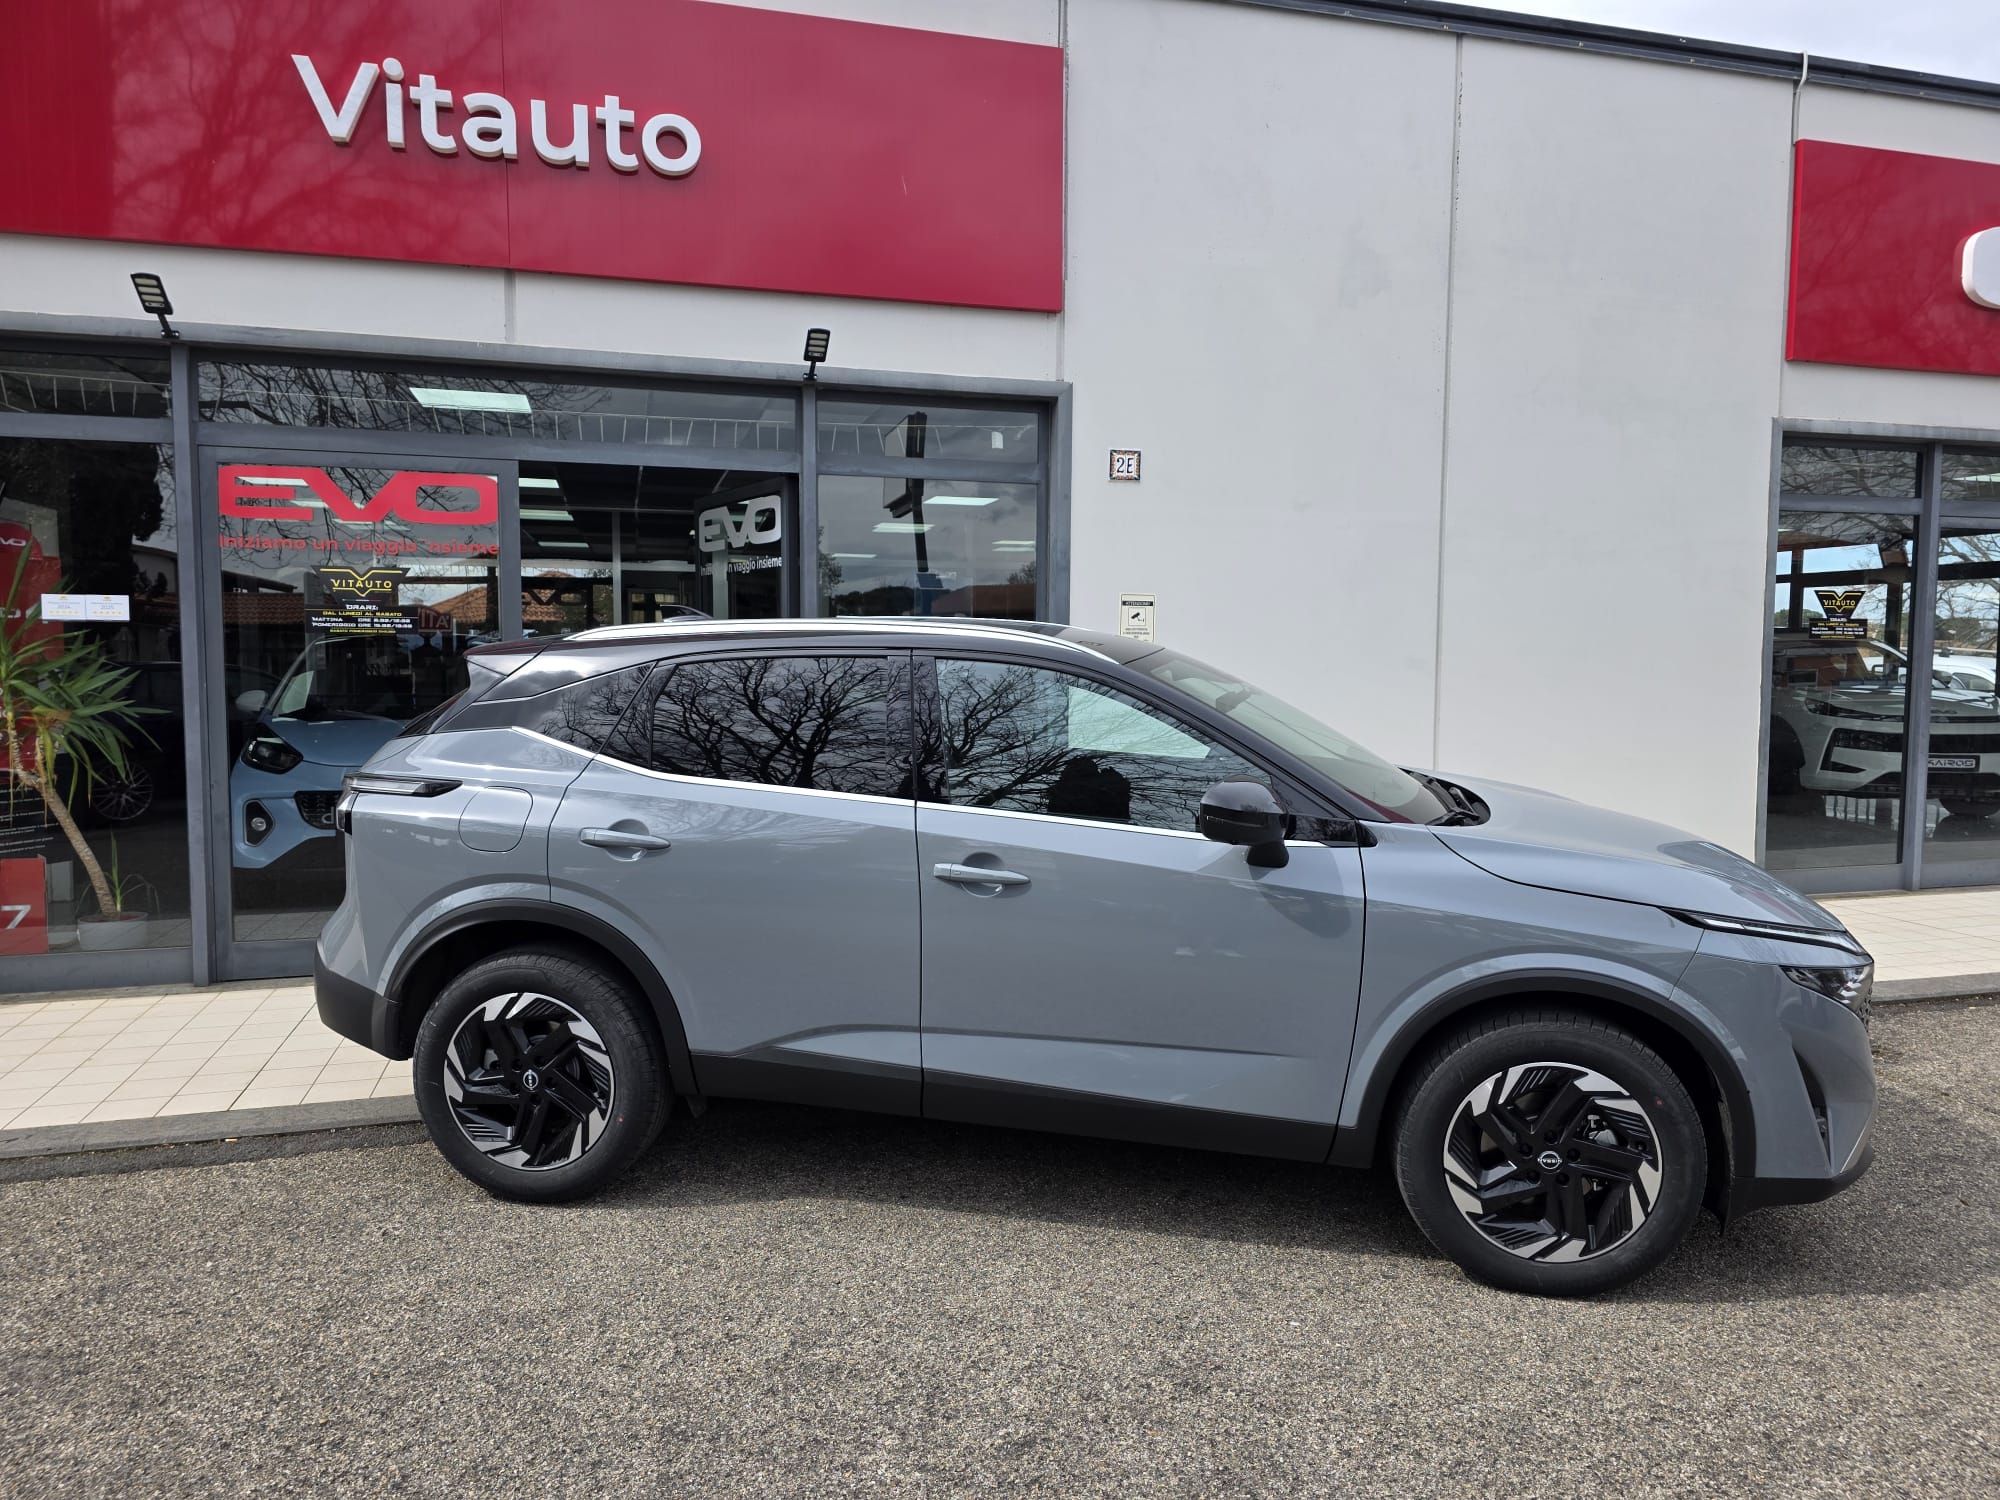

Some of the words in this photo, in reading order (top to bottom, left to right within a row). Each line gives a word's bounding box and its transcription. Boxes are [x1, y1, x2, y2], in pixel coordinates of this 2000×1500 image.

[291, 54, 701, 176] Vitauto
[1117, 457, 1134, 473] 2E
[217, 463, 499, 526] EVO
[699, 495, 781, 552] EVO
[218, 533, 306, 550] Iniziamo
[312, 538, 338, 551] un
[345, 534, 417, 556] viaggio
[733, 558, 756, 574] viaggio
[756, 555, 782, 569] insieme
[330, 579, 392, 589] VITAUTO
